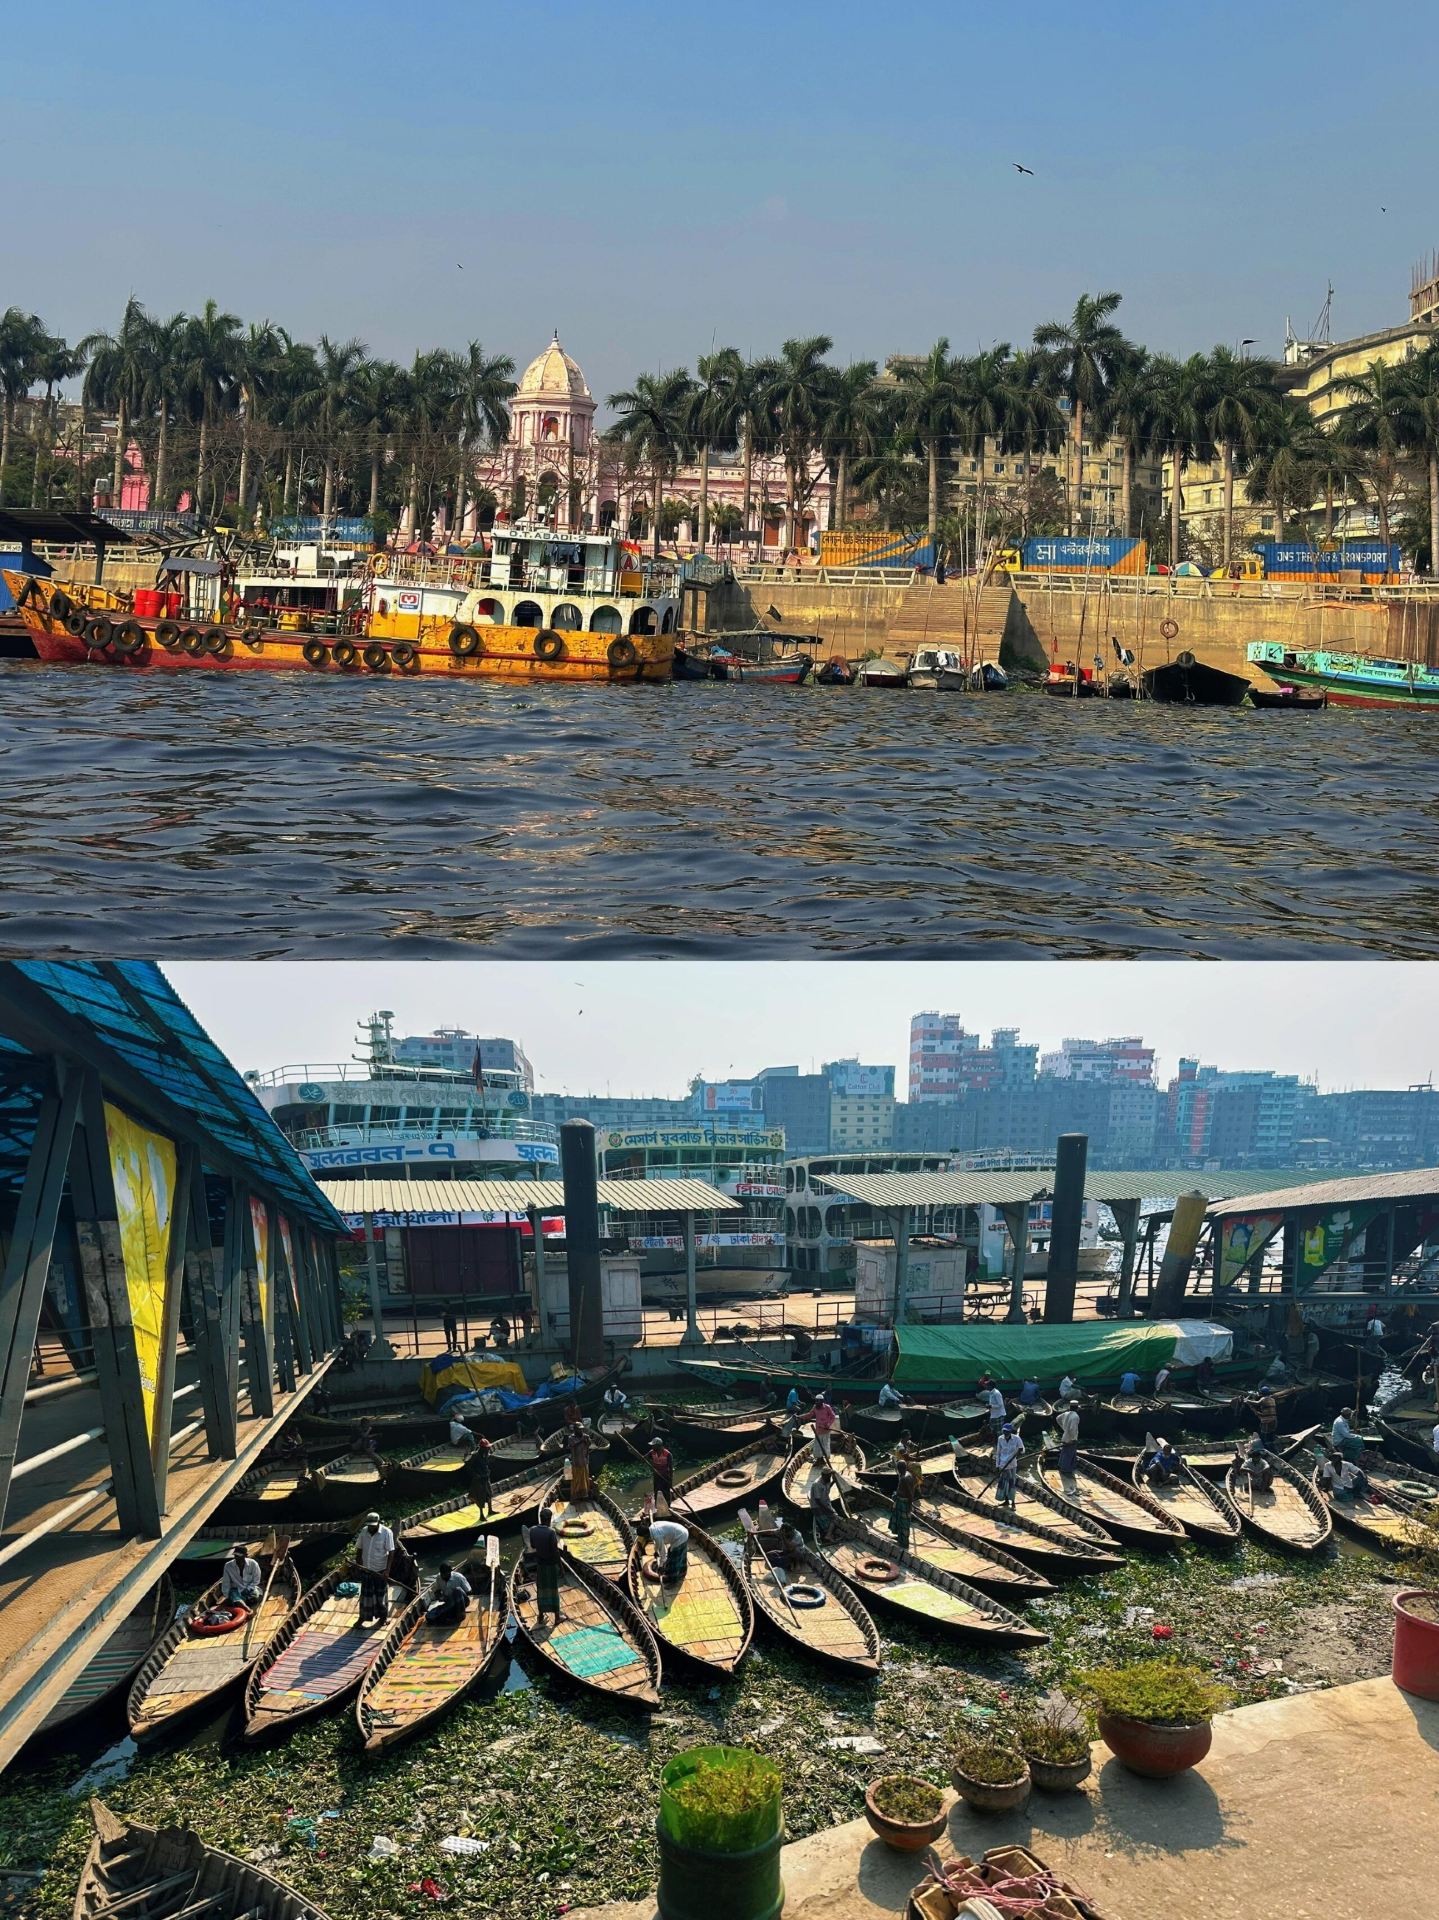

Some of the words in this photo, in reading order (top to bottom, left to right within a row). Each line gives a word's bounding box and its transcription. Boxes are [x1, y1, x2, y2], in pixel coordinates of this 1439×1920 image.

[1036, 544, 1056, 561] মা
[1296, 551, 1331, 563] TRAING
[1340, 552, 1388, 564] TRANSPORT
[393, 580, 422, 588] SAFETY
[424, 582, 446, 590] FIRST
[624, 1131, 658, 1147] মেসার্স
[660, 1131, 703, 1147] যুবরাজ
